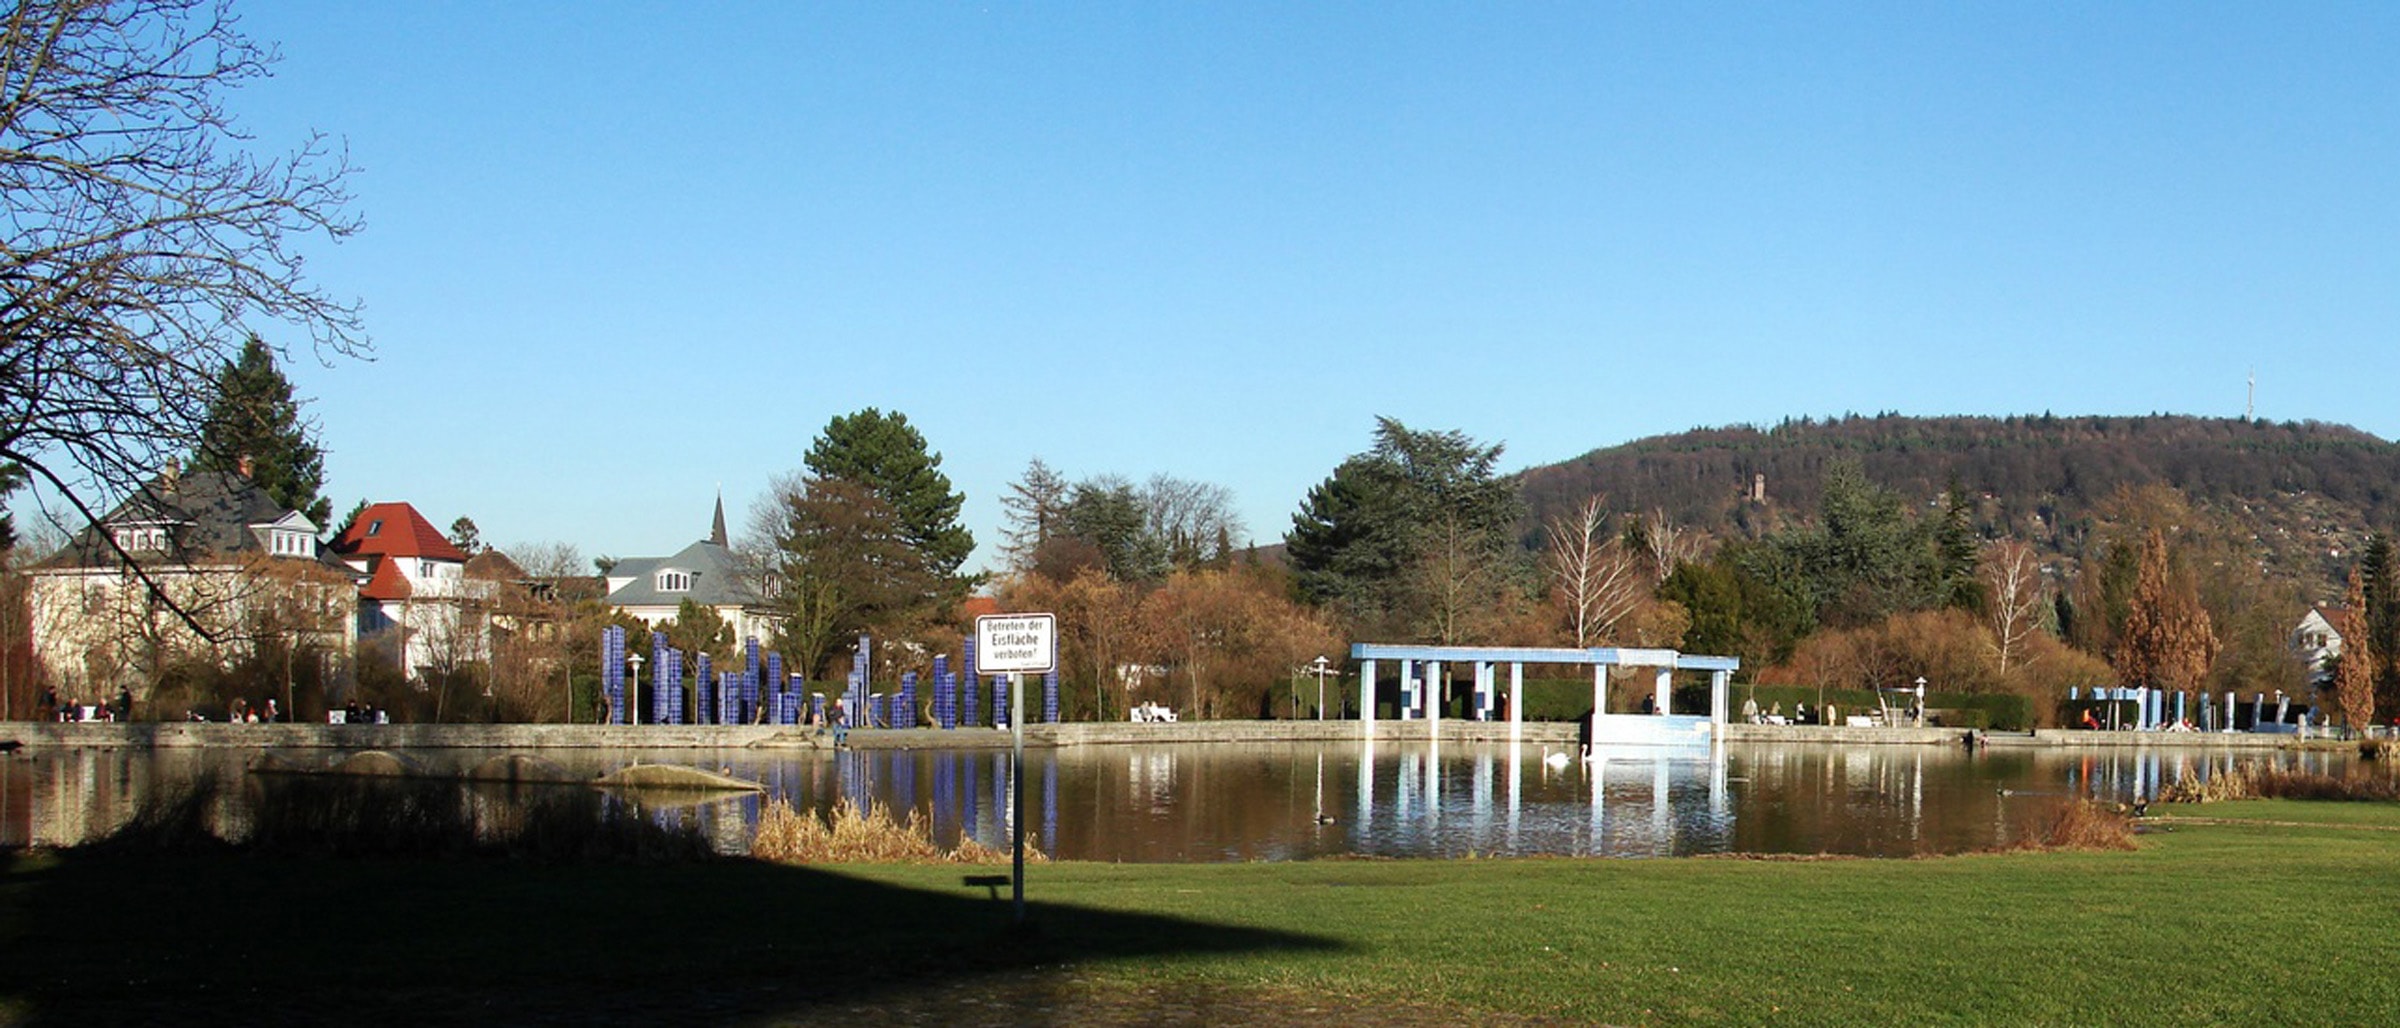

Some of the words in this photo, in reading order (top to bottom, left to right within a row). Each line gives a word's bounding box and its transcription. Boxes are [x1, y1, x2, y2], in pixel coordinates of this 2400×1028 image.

[987, 620, 1025, 632] Betreten
[1028, 619, 1043, 631] der
[992, 632, 1039, 646] Eisfläche
[993, 647, 1037, 659] verboten!
